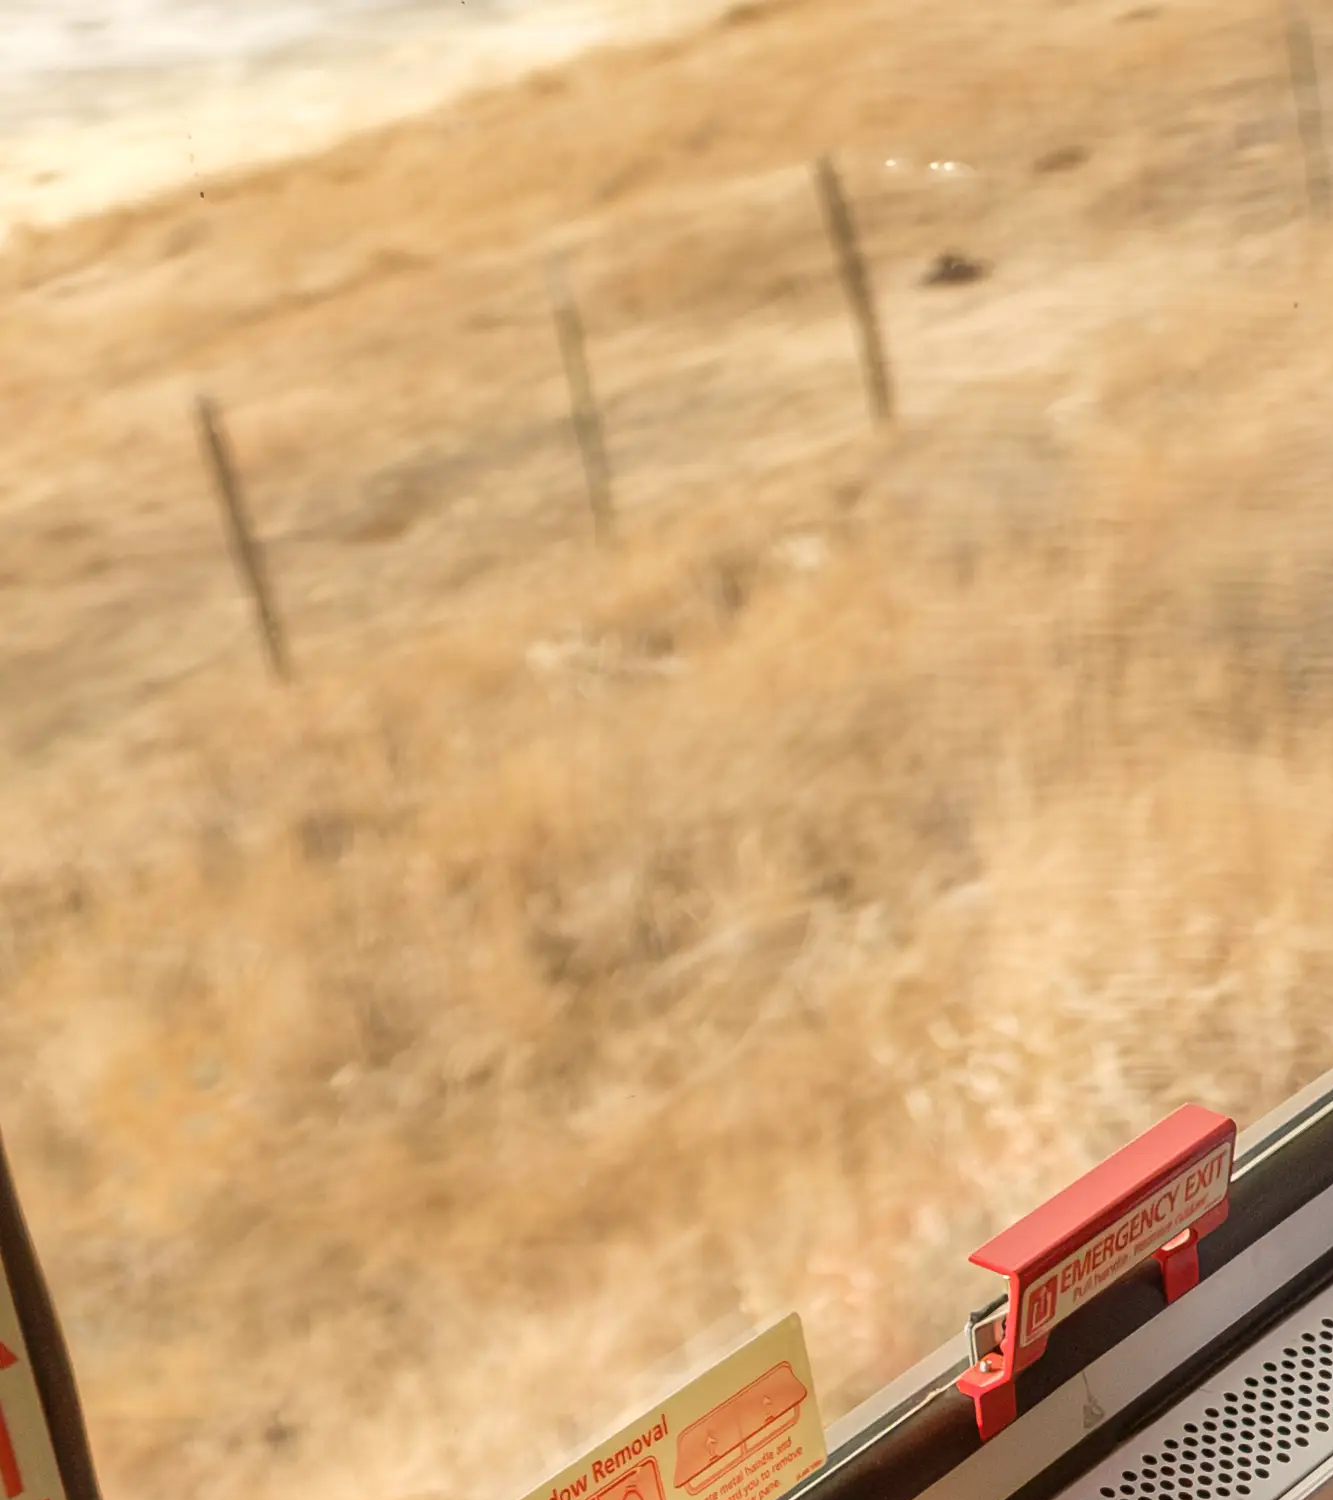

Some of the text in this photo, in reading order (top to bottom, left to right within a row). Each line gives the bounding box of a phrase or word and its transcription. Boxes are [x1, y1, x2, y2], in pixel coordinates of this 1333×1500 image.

[1060, 1153, 1225, 1294] EMERGENCY EXIT
[590, 1412, 669, 1485] Removal
[775, 1434, 792, 1456] and
[742, 1475, 759, 1498] you
[760, 1467, 770, 1482] to
